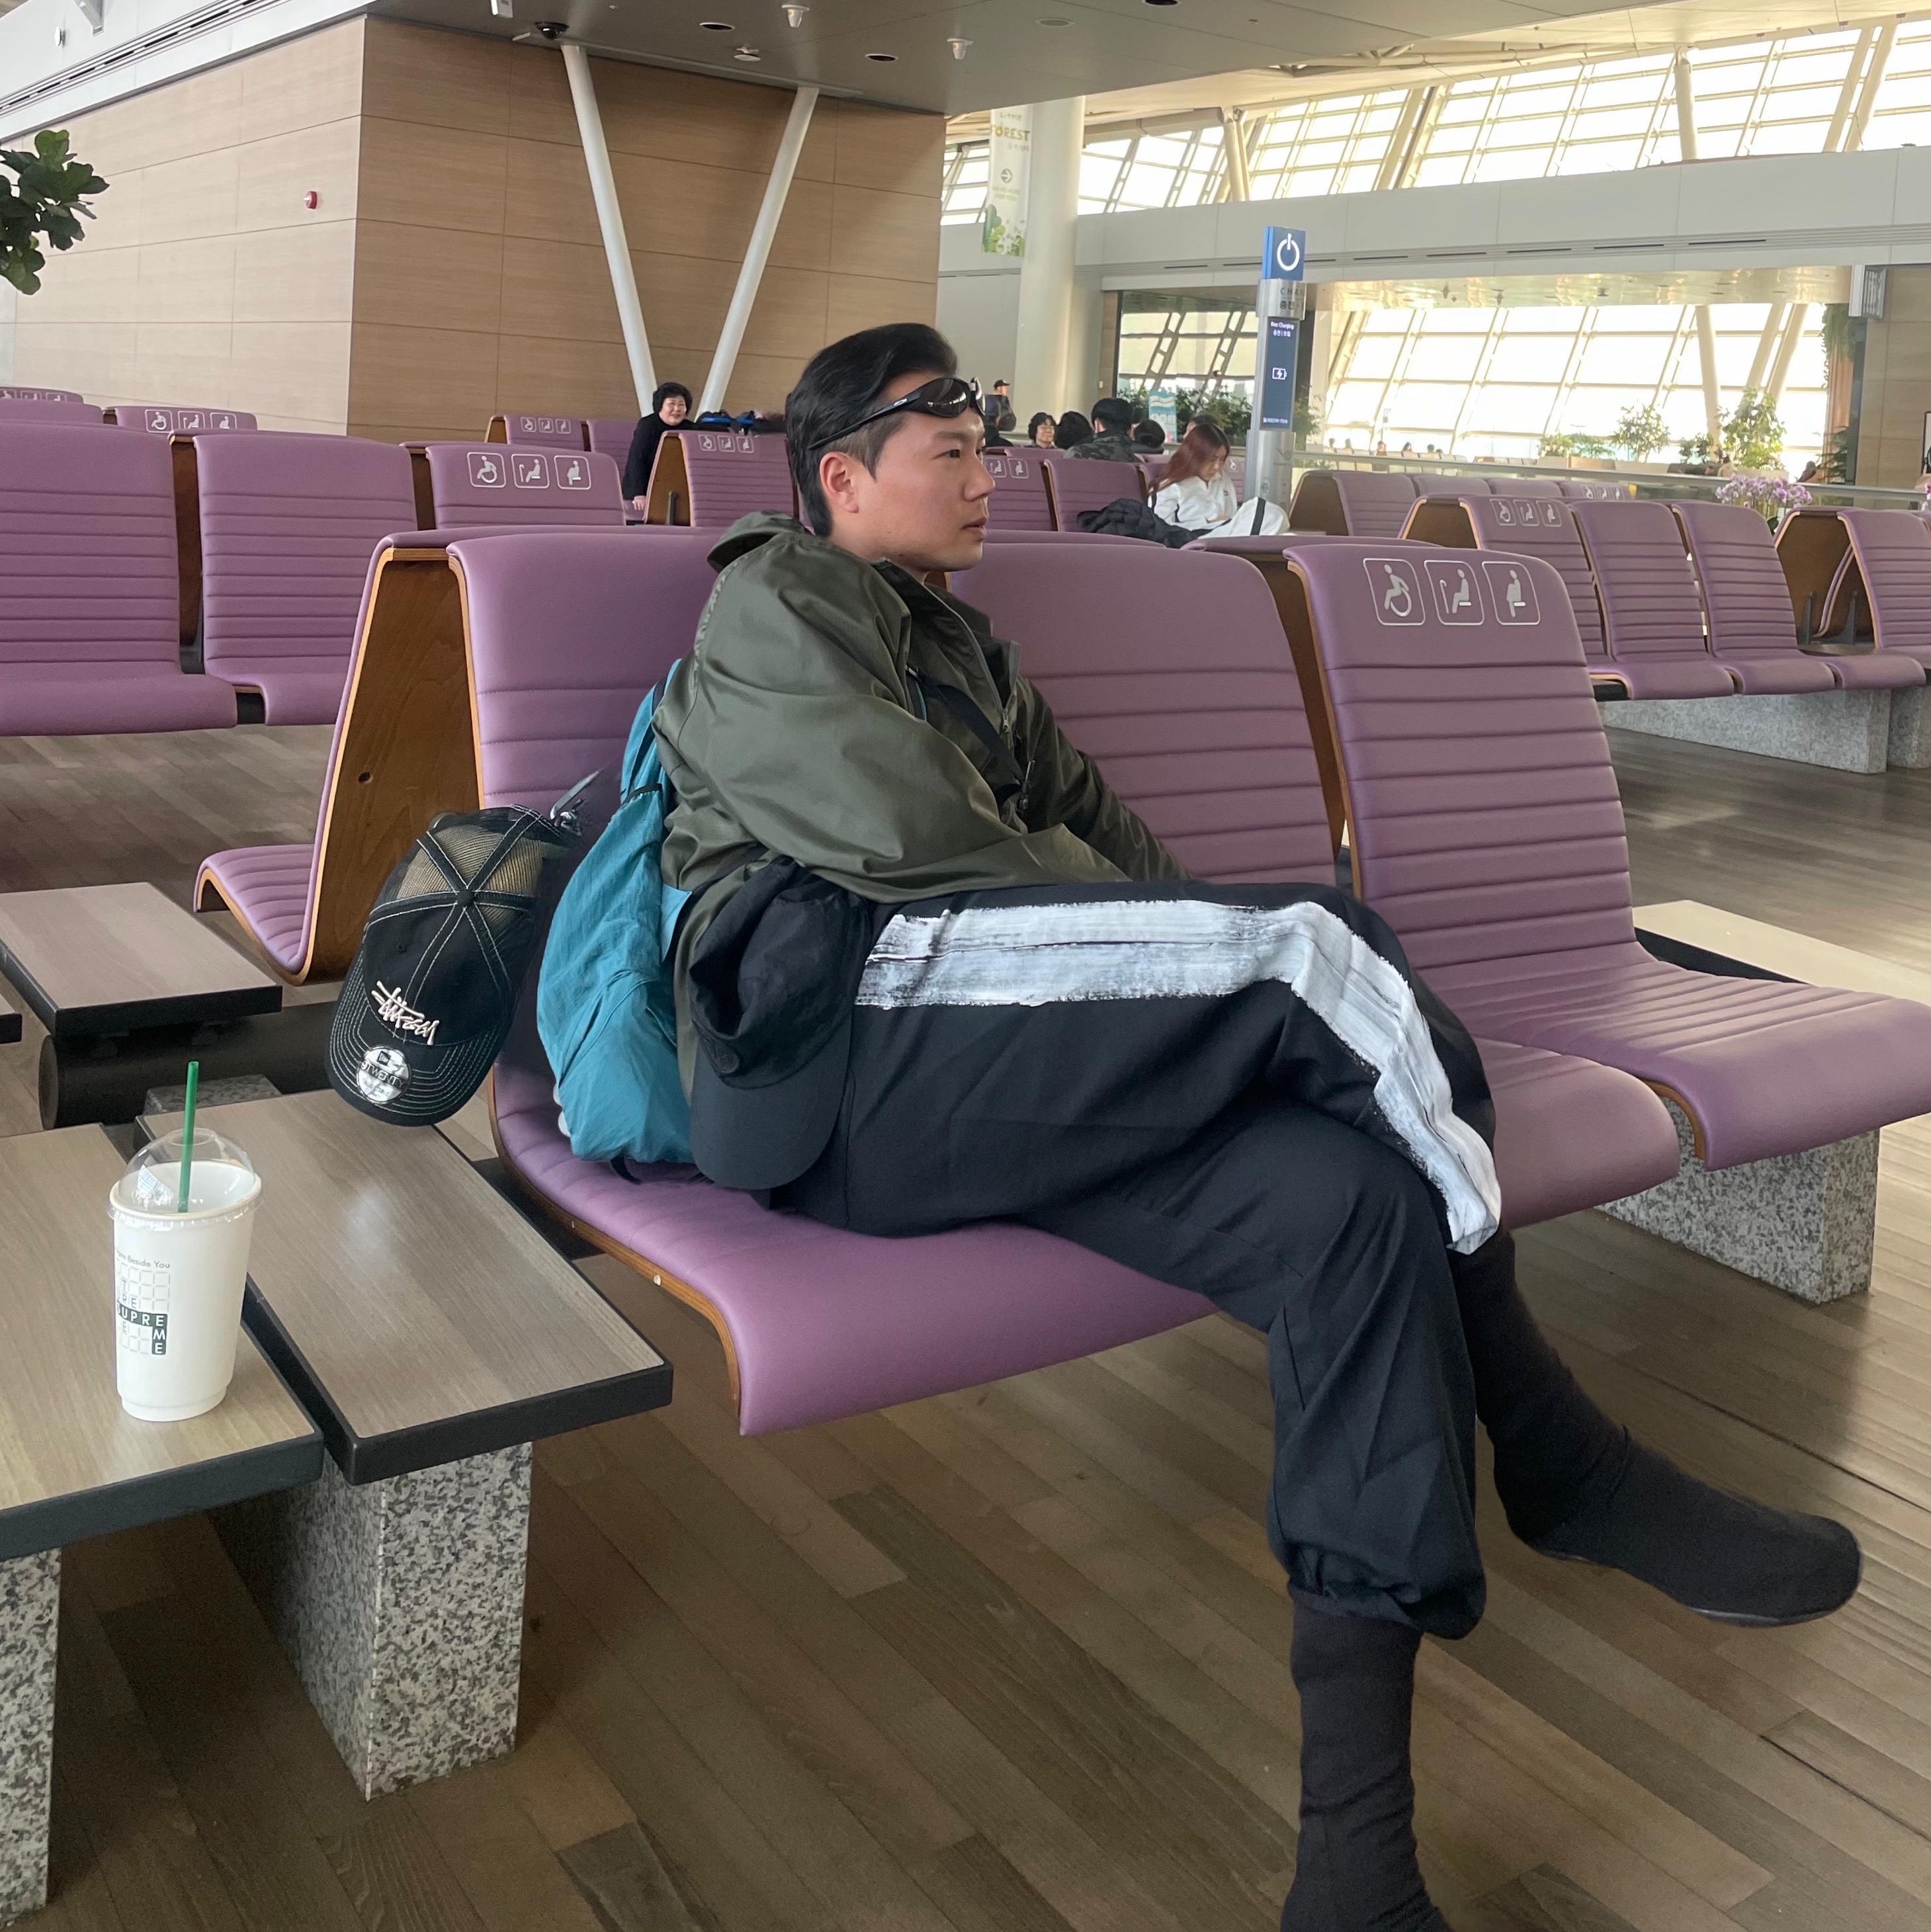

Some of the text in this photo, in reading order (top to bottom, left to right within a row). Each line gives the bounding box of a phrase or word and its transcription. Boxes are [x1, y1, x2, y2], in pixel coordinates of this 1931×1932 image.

[361, 1060, 408, 1089] 9TWENTY
[127, 1255, 151, 1267] Beside
[153, 1260, 170, 1269] You
